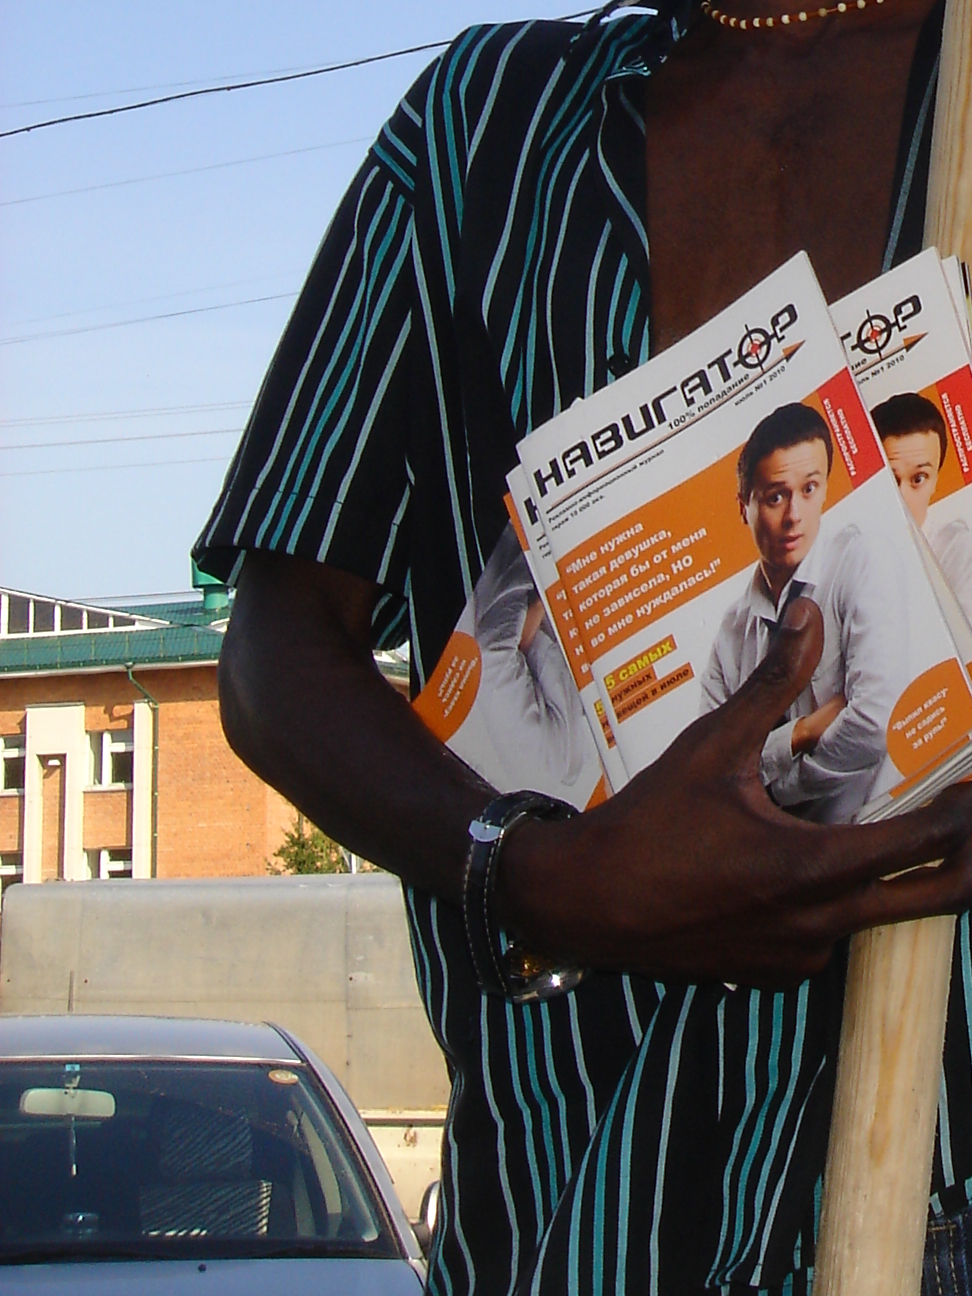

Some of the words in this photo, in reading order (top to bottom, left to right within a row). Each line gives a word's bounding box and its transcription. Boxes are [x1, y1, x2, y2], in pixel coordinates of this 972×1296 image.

[769, 365, 786, 382] 2010
[533, 303, 799, 498] НАВИГАТОР
[667, 409, 696, 430] 100%
[697, 373, 750, 413] попадание
[571, 566, 607, 595] такая
[609, 527, 673, 572] девушка,
[600, 521, 644, 555] нужна
[578, 574, 629, 613] которая
[630, 558, 651, 578] бы
[653, 549, 668, 565] от
[671, 526, 707, 555] меня
[584, 613, 600, 631] не
[602, 570, 671, 618] зависела,
[671, 554, 694, 575] НО
[590, 631, 606, 648] во
[607, 614, 634, 636] мне
[605, 673, 616, 690] 5
[618, 640, 673, 682] самых
[610, 672, 653, 705] нужных
[660, 668, 690, 692] июле
